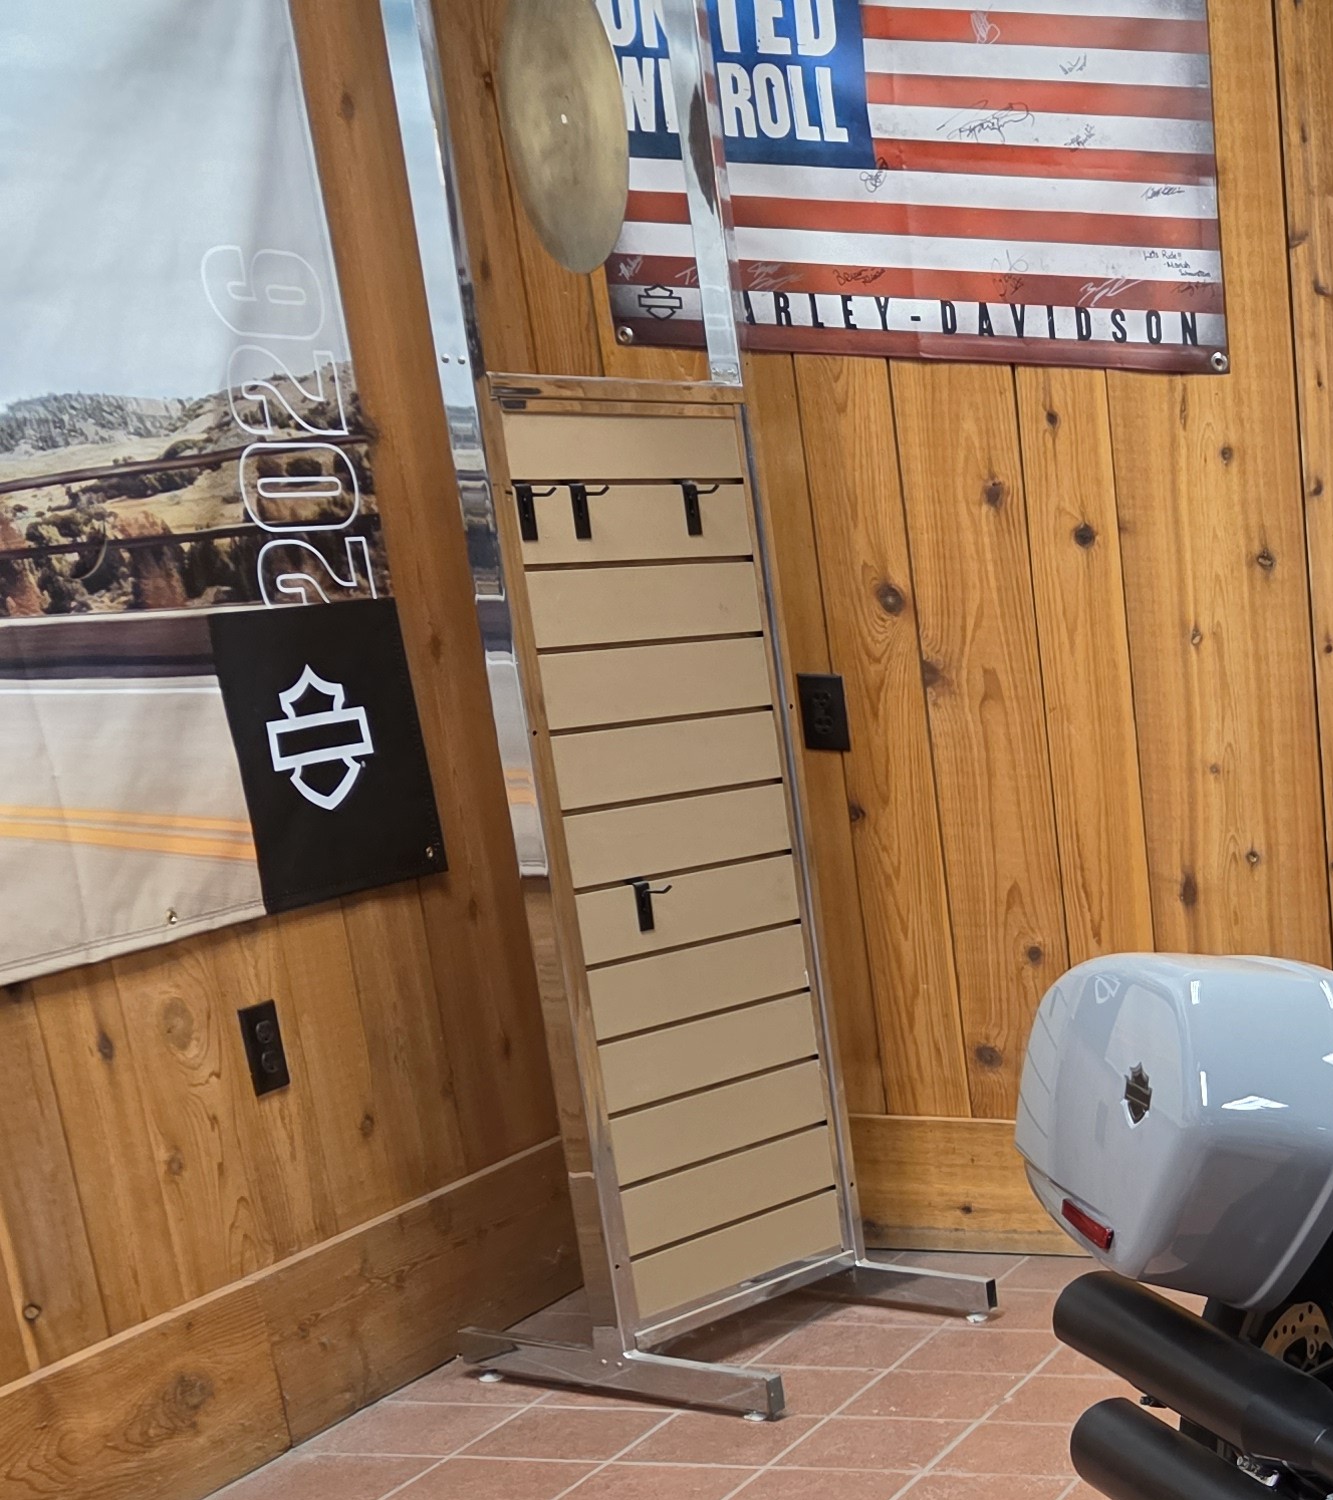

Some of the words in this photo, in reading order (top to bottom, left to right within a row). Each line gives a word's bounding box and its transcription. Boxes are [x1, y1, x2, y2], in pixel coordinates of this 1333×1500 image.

[595, 0, 837, 56] UNTED
[717, 62, 849, 142] ROLL
[742, 289, 1199, 346] ARLEY-DAVIDSON
[200, 244, 378, 609] 2026
